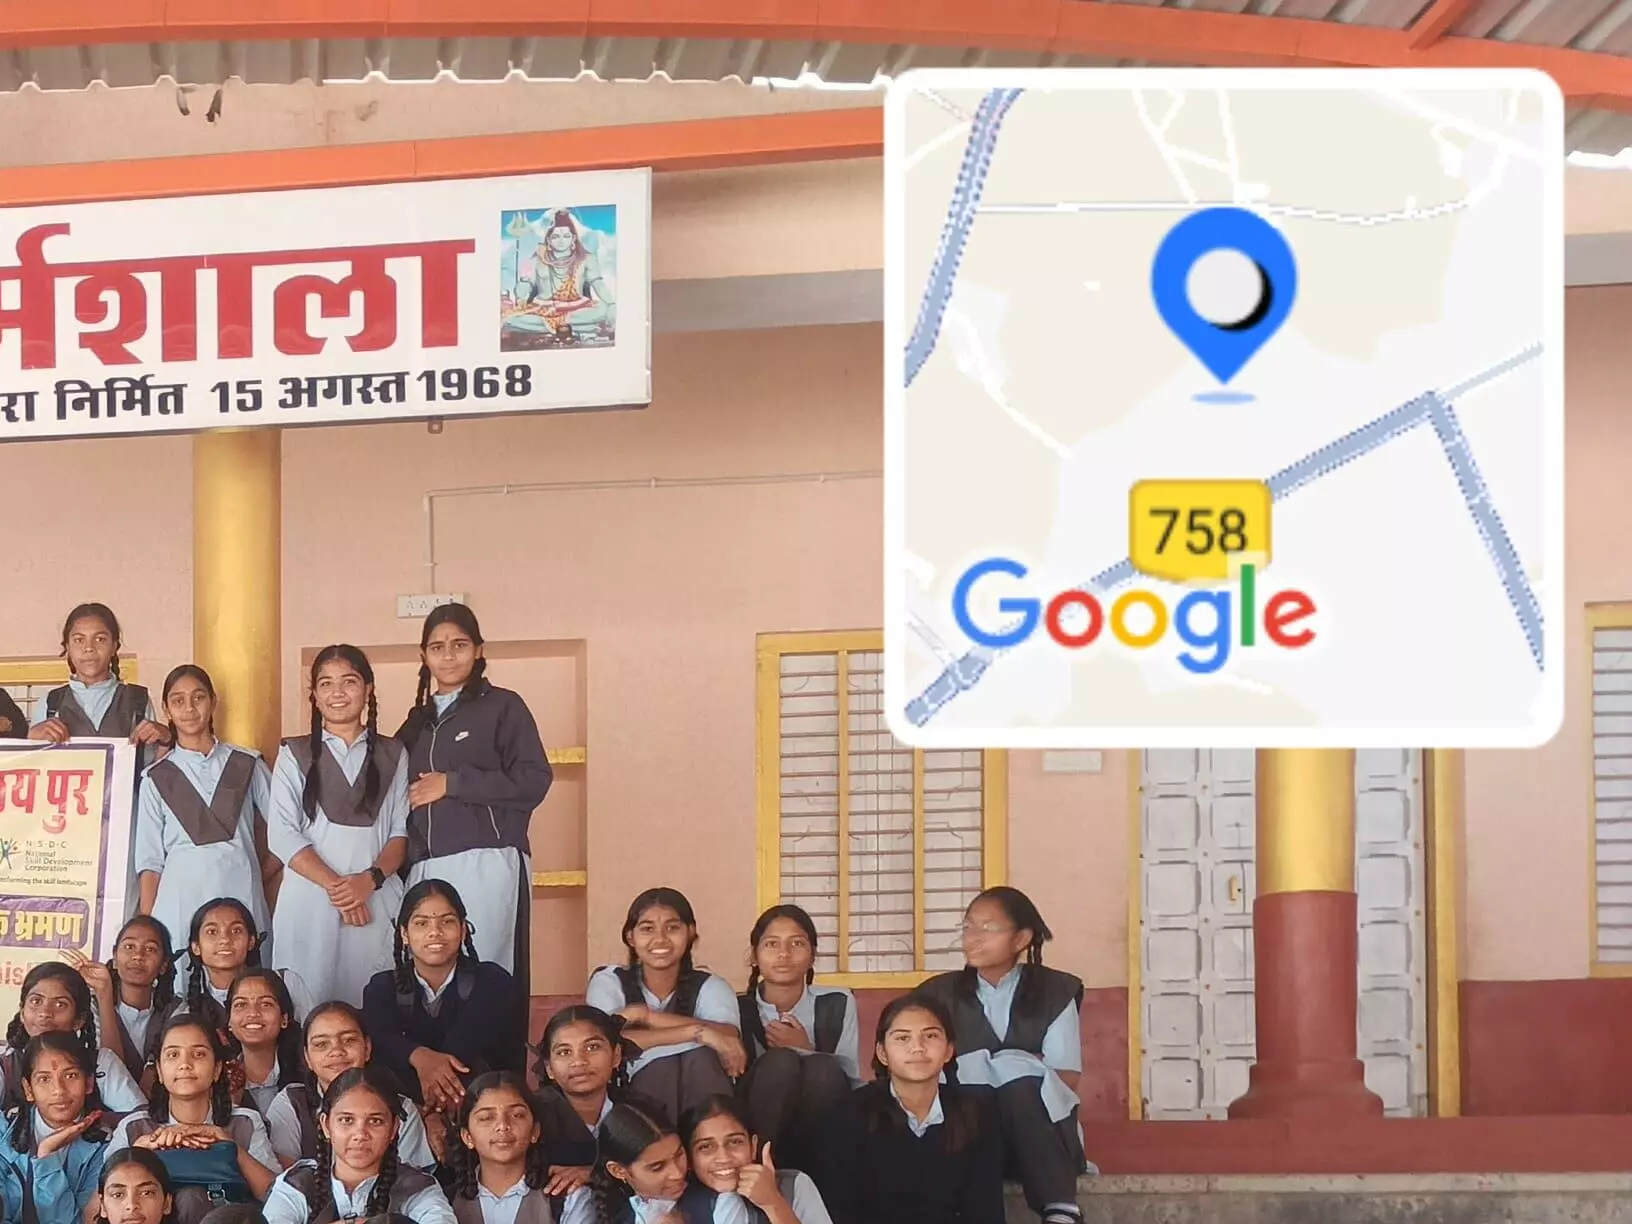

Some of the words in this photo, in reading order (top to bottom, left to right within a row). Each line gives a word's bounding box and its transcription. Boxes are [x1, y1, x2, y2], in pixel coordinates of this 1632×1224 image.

[55, 374, 188, 421] निर्मित
[210, 379, 263, 414] 15
[278, 371, 410, 409] अगस्त
[416, 364, 532, 402] 1968
[42, 769, 94, 834] पुर
[14, 908, 85, 943] भ्रमण
